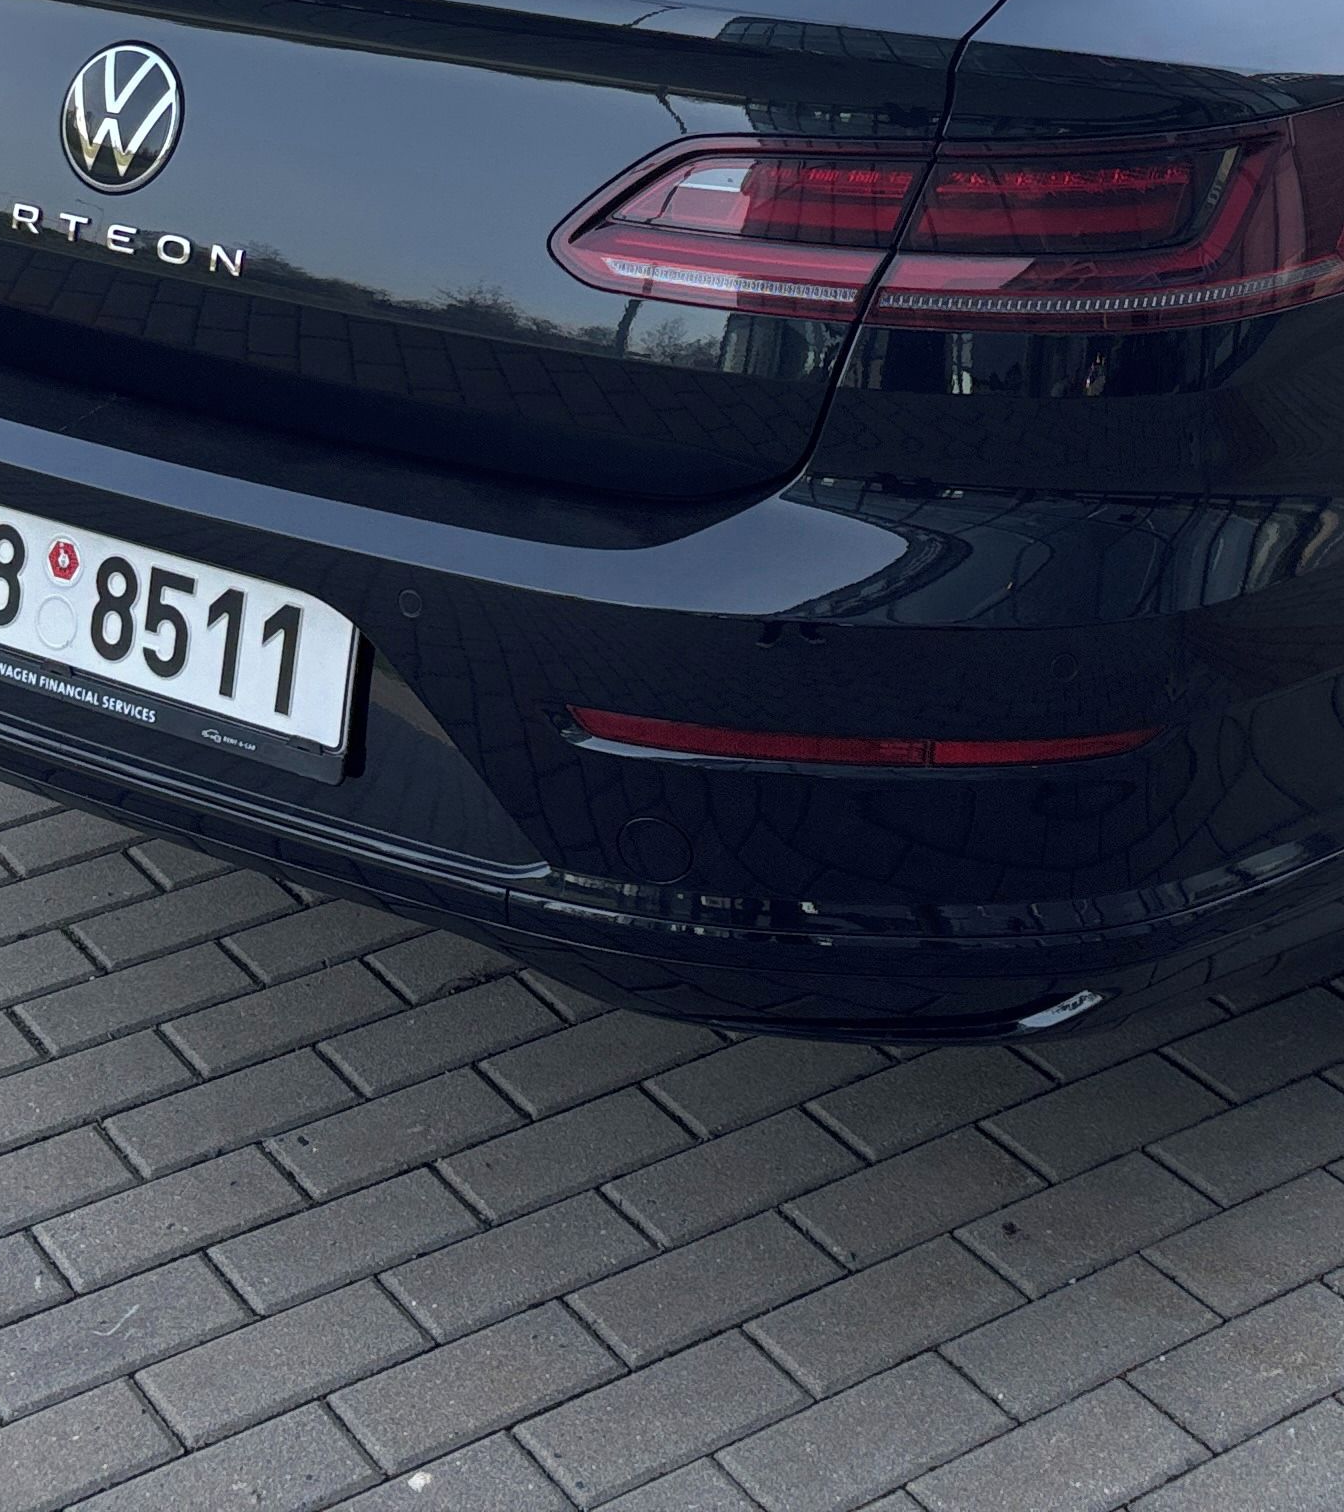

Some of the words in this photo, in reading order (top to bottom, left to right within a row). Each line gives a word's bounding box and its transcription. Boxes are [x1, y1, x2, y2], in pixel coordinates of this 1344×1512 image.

[90, 555, 306, 718] 8511
[39, 675, 100, 707] FINANCIAL
[102, 695, 156, 725] SERVICES
